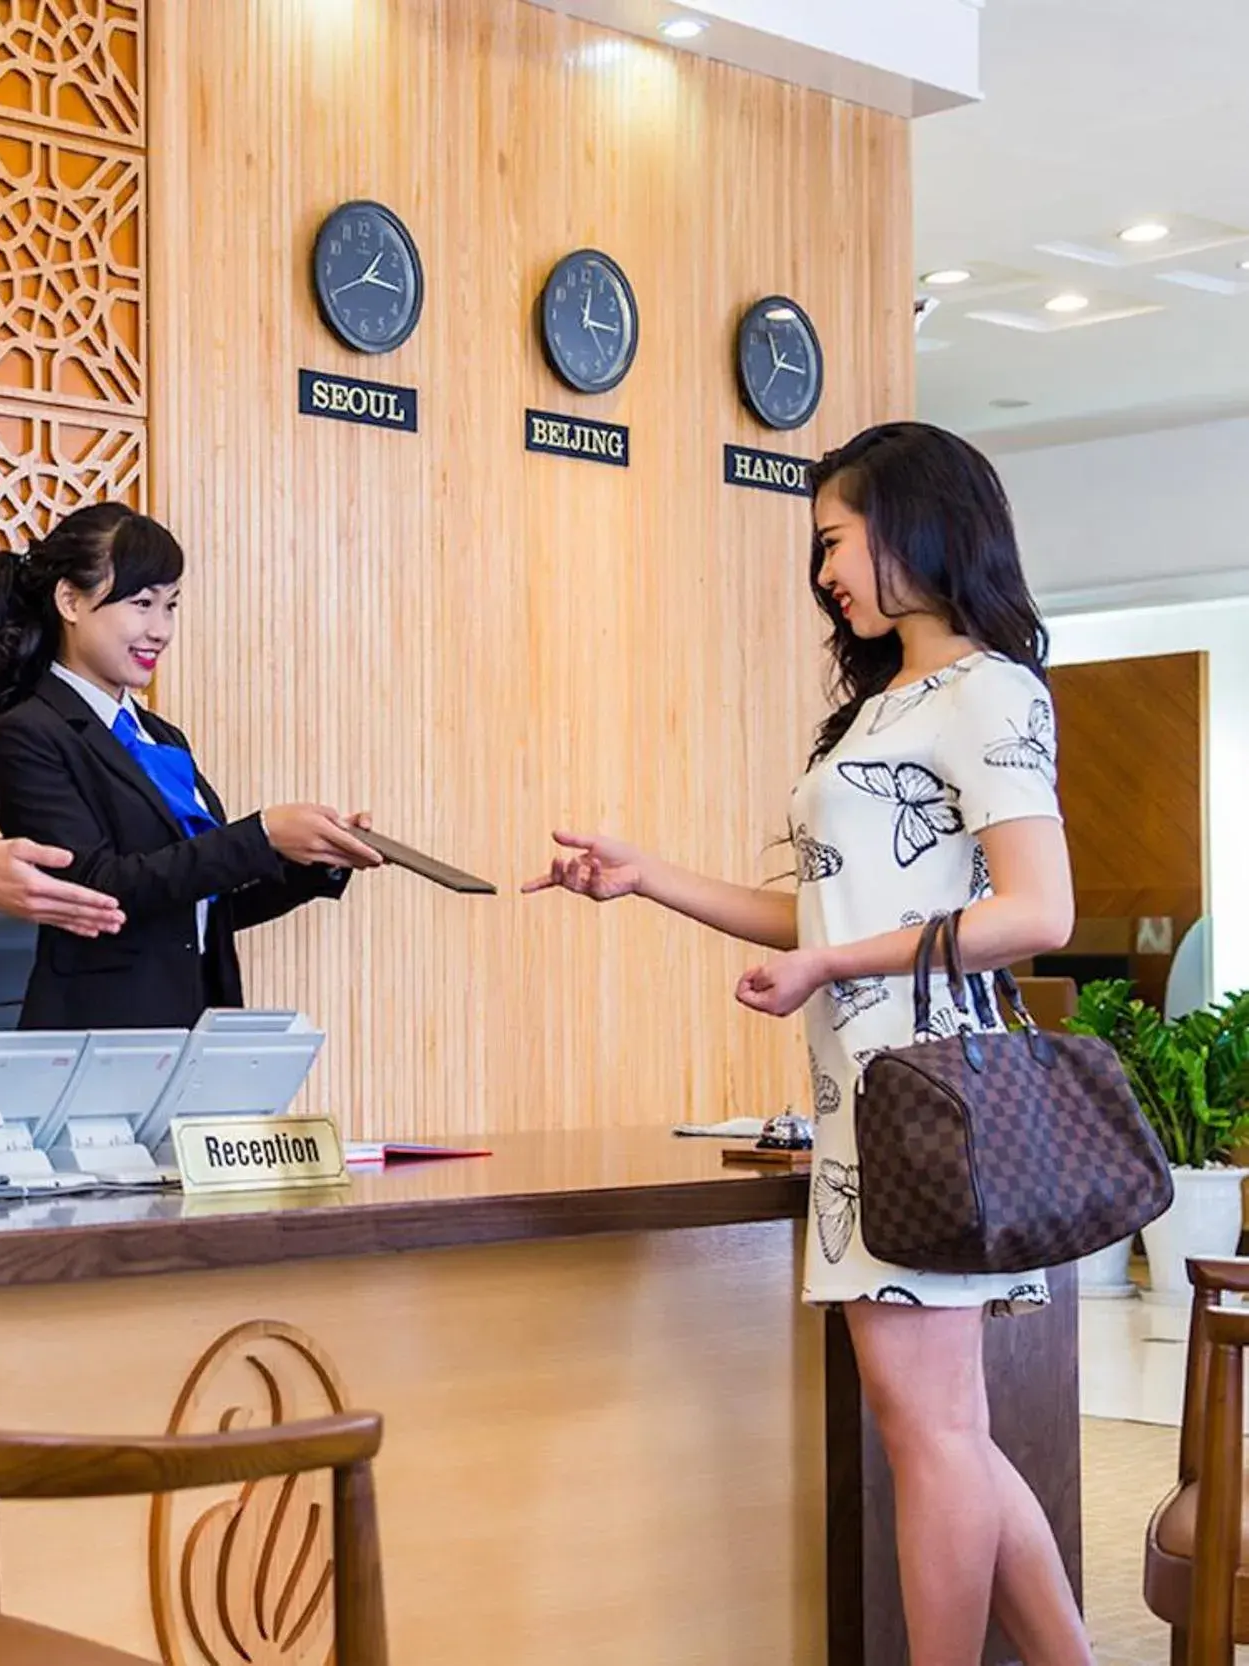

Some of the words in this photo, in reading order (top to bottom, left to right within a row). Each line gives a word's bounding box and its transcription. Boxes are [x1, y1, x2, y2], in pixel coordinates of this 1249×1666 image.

[312, 380, 405, 421] SEOUL
[531, 417, 624, 458] BEIJING
[733, 453, 807, 489] HANOI
[204, 1132, 320, 1169] Reception
